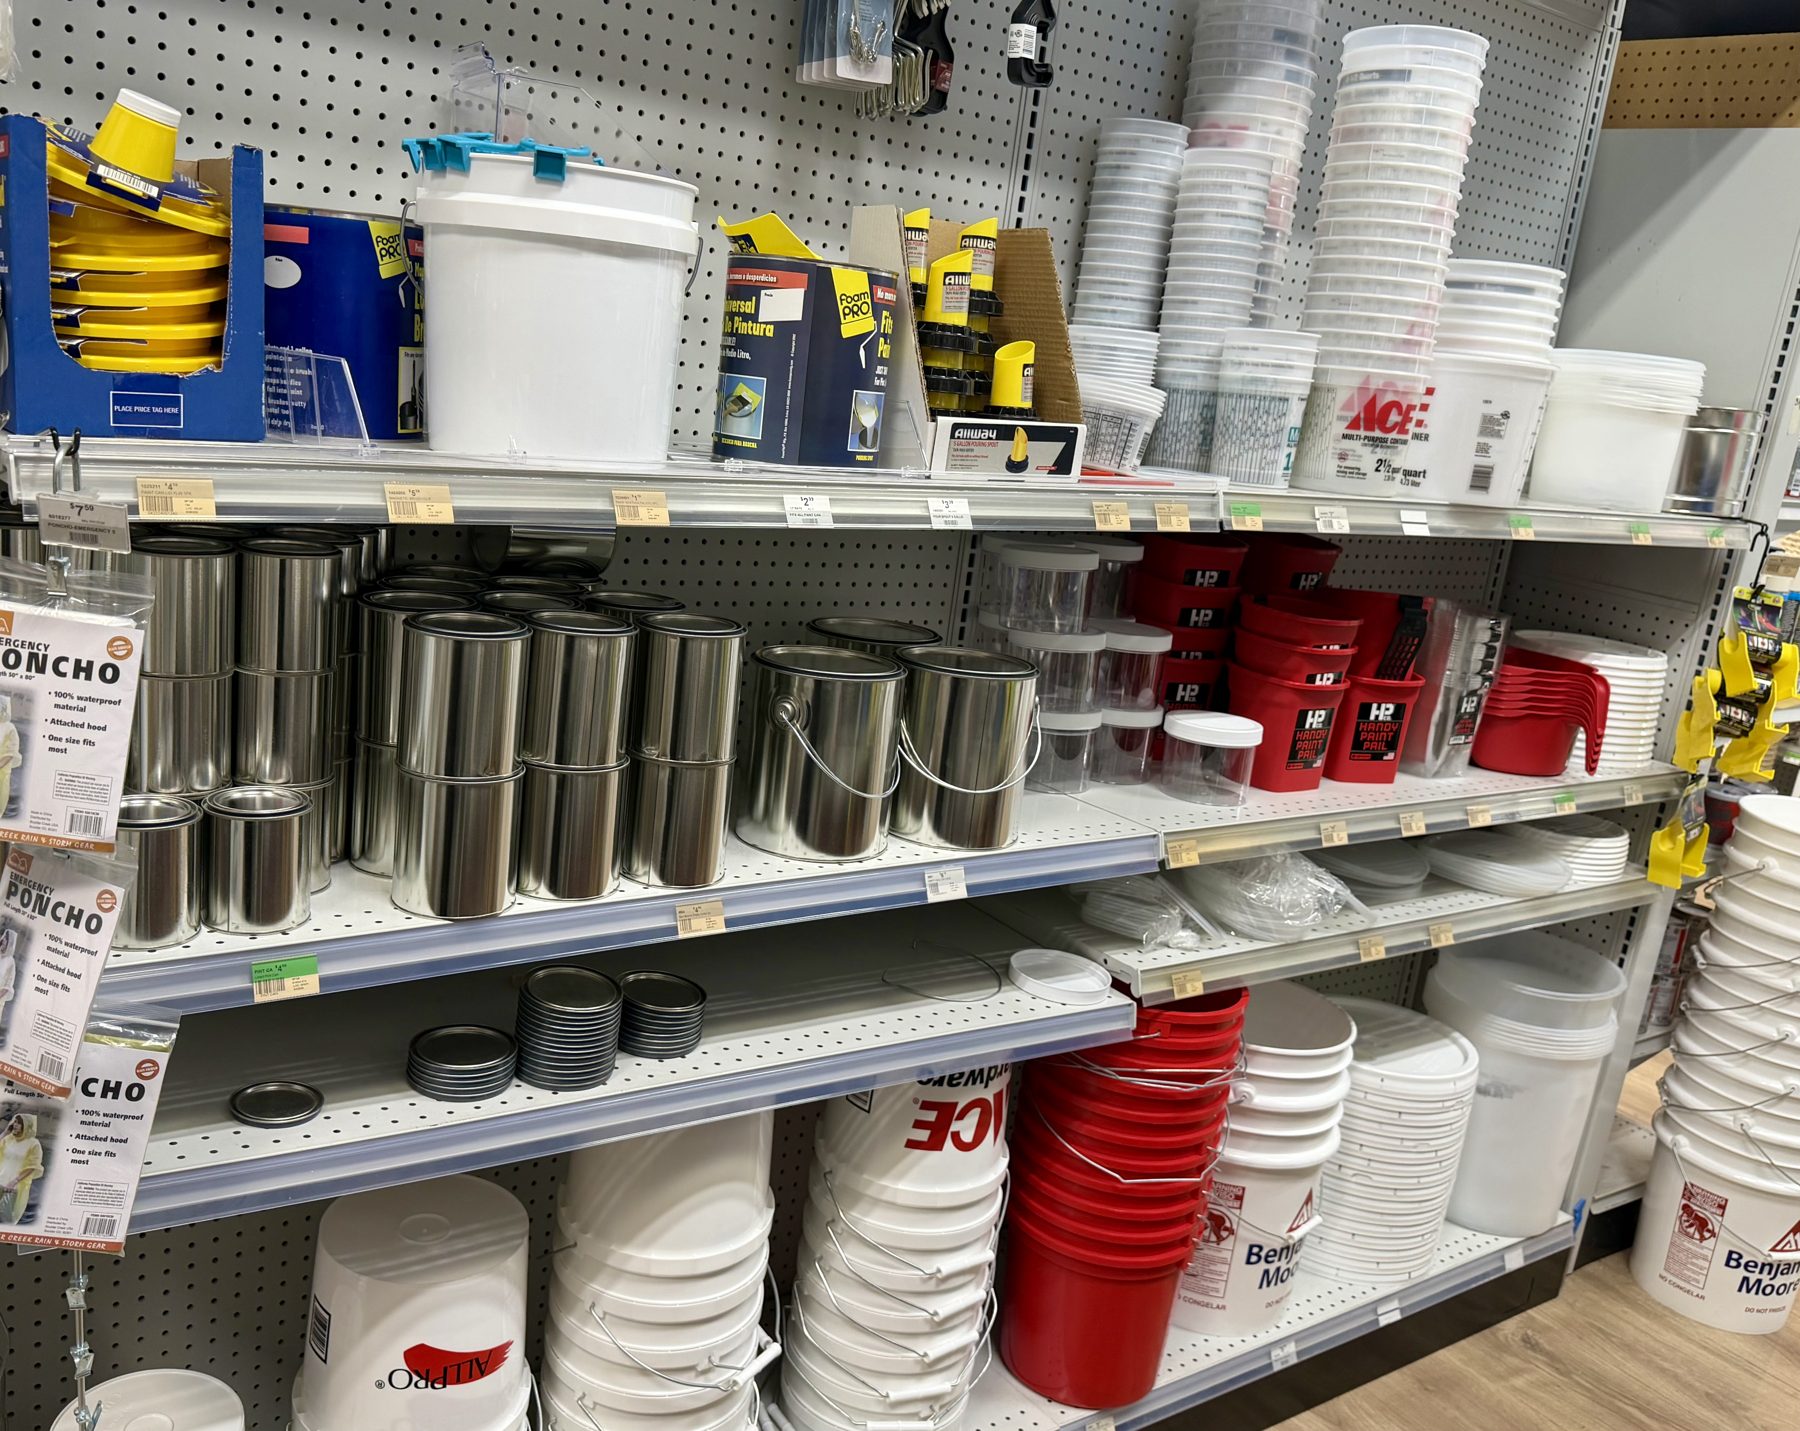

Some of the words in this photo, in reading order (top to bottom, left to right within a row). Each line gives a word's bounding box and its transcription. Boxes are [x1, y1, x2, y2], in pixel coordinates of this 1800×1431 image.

[842, 301, 870, 320] PRO
[734, 316, 774, 337] Pintura
[1344, 394, 1417, 435] ACE
[954, 428, 997, 440] Allway
[1341, 433, 1389, 444] MULTI-PURPOSE
[1402, 468, 1427, 479] quart
[2, 648, 120, 684] ONCHO
[54, 690, 74, 700] 100%
[77, 694, 121, 706] waterproof
[1176, 684, 1199, 702] HP
[54, 703, 86, 713] material
[1369, 703, 1395, 720] HP
[50, 718, 85, 729] Attached
[87, 723, 107, 731] hood
[1305, 710, 1326, 729] HP
[1359, 723, 1399, 731] HANDY
[48, 734, 63, 742] One
[65, 736, 80, 744] size
[83, 739, 96, 747] fits
[1296, 729, 1327, 740] HANDY
[1360, 732, 1393, 741] PAINT
[1296, 740, 1324, 750] PAINT
[1363, 741, 1387, 751] PAIL
[1298, 750, 1317, 759] PAIL
[21, 834, 38, 842] RAIN
[49, 837, 72, 846] STORM
[74, 841, 95, 849] GEAR
[10, 872, 55, 895] EMERGENCY
[5, 880, 103, 935] PONCHO
[46, 945, 70, 958] material
[48, 933, 63, 945] 100%
[64, 940, 98, 957] waterproof
[41, 959, 65, 974] Attached
[66, 969, 82, 980] hood
[37, 974, 48, 984] One
[48, 978, 60, 988] size
[61, 983, 71, 992] fits
[34, 986, 49, 996] most
[16, 1089, 35, 1097] Length
[75, 1076, 146, 1102] CHO
[81, 1109, 100, 1117] 100%
[103, 1111, 144, 1121] waterproof
[80, 1119, 111, 1128] material
[74, 1133, 108, 1143] Attached
[109, 1136, 128, 1144] hood
[71, 1148, 86, 1156] One
[104, 1150, 117, 1158] fits
[7, 1234, 33, 1242] CREEK
[34, 1236, 52, 1245] RAIN
[62, 1240, 85, 1248] STORM
[86, 1242, 106, 1250] GEAR
[1667, 1279, 1706, 1301] CONGELAR
[1737, 1276, 1800, 1297] Moore
[1183, 1295, 1226, 1311] CONGELAR
[388, 1349, 493, 1390] ALLPRO
